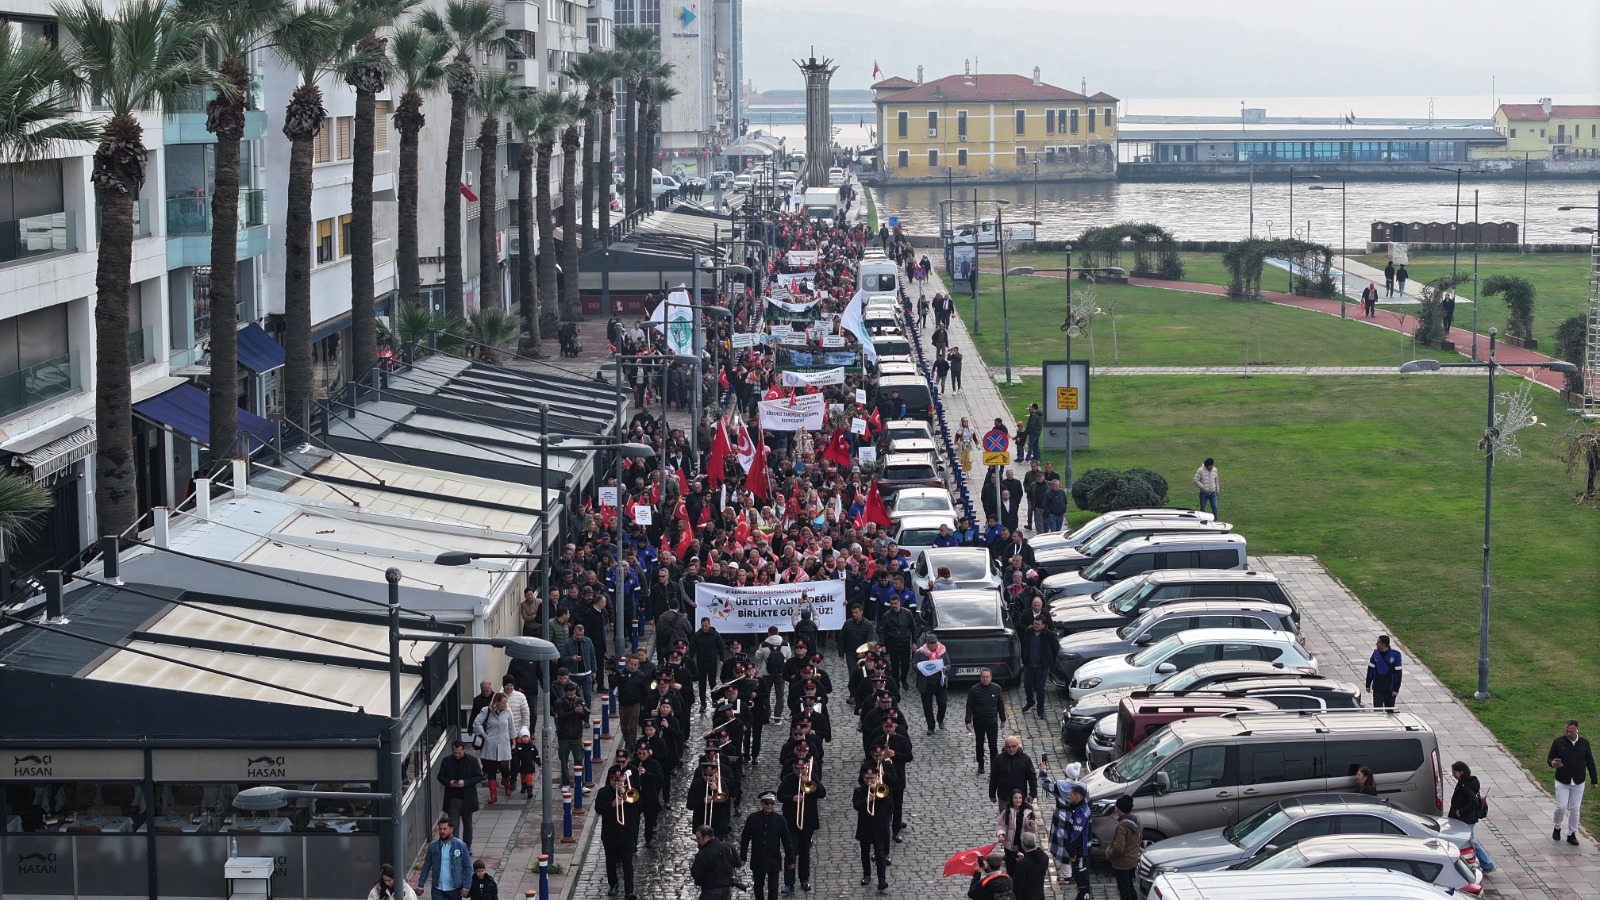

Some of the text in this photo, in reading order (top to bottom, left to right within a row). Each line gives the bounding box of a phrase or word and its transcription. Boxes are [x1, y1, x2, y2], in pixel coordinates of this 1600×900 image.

[736, 597, 772, 606] ÜRETİCİ
[810, 593, 835, 603] DEĞİL
[738, 608, 778, 617] BİRLİKTE
[43, 755, 52, 765] ÇI
[276, 756, 285, 766] ÇI
[14, 768, 52, 776] HASAN
[247, 769, 286, 777] HASAN
[18, 865, 57, 874] HASAN
